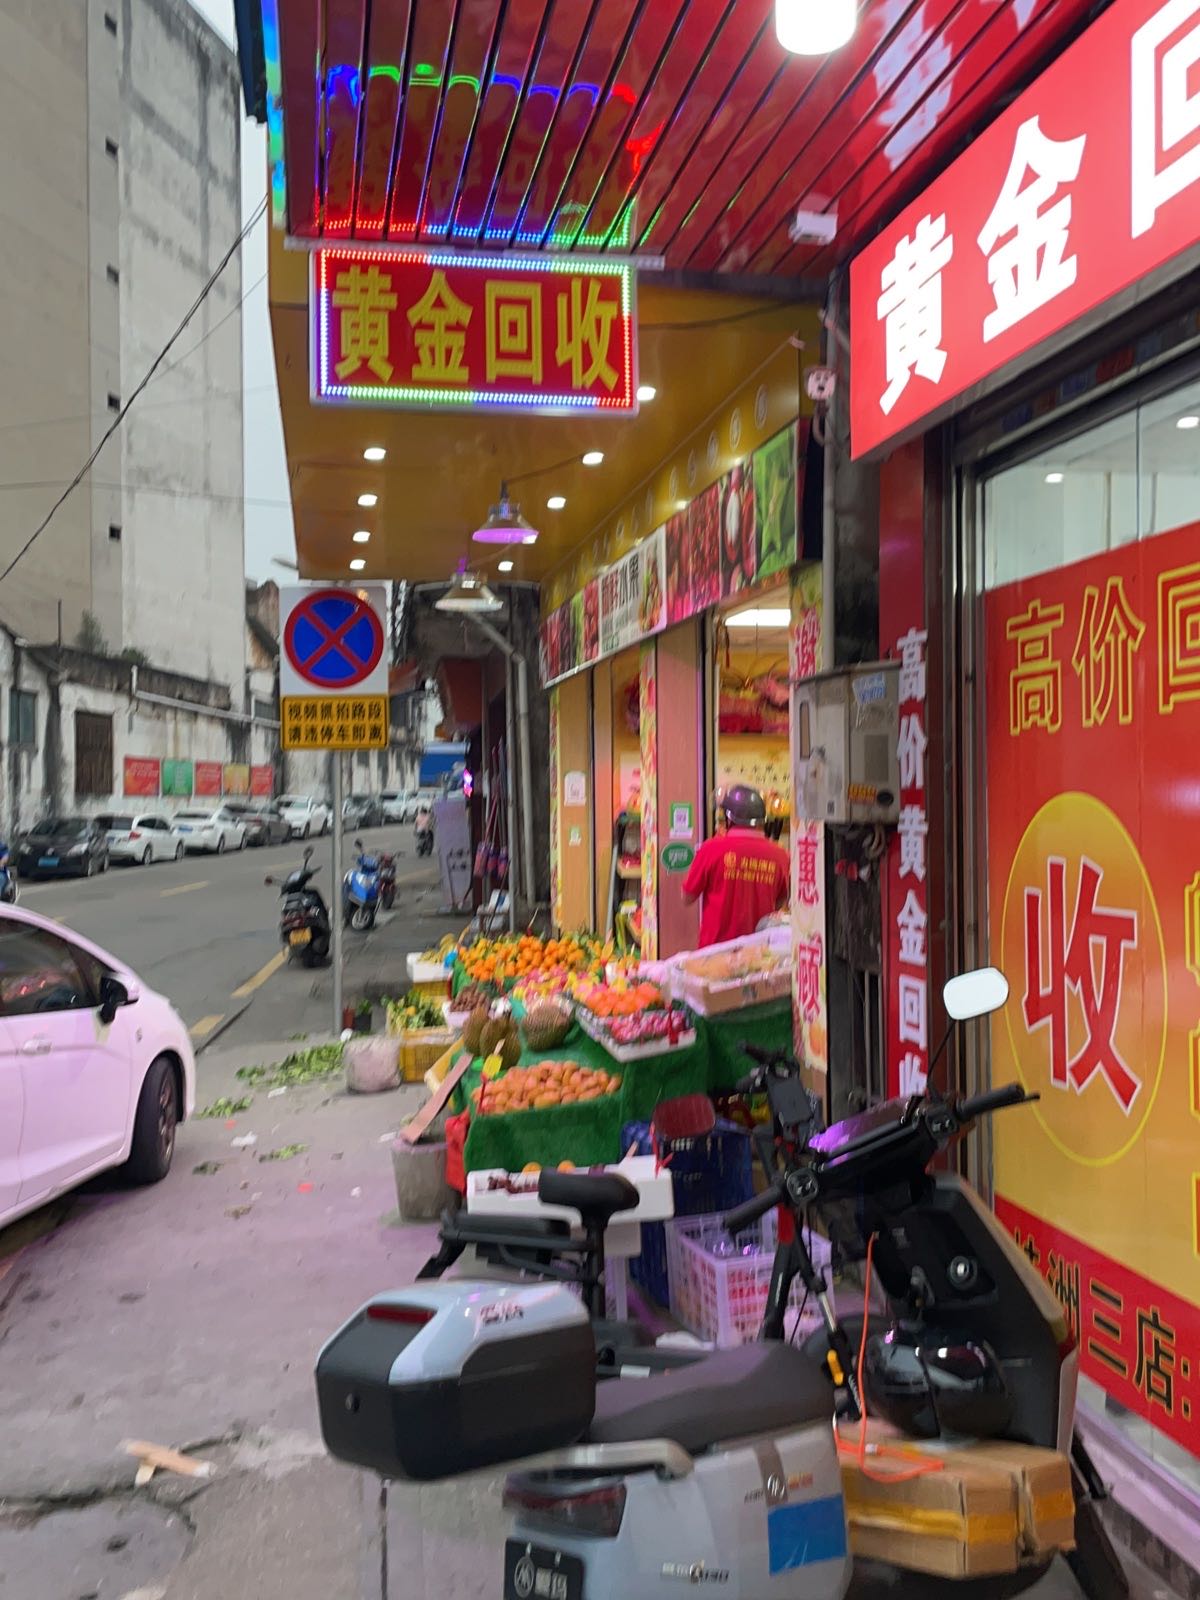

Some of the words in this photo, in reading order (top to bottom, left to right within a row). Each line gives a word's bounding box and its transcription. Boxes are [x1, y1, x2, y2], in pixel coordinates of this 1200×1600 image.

[332, 265, 619, 392] 黄金回收
[288, 702, 382, 722] 视频抓拍路段
[794, 607, 822, 1025] 谢惠顾
[1021, 855, 1142, 1117] 收
[1014, 1226, 1192, 1421] 洲三店:
